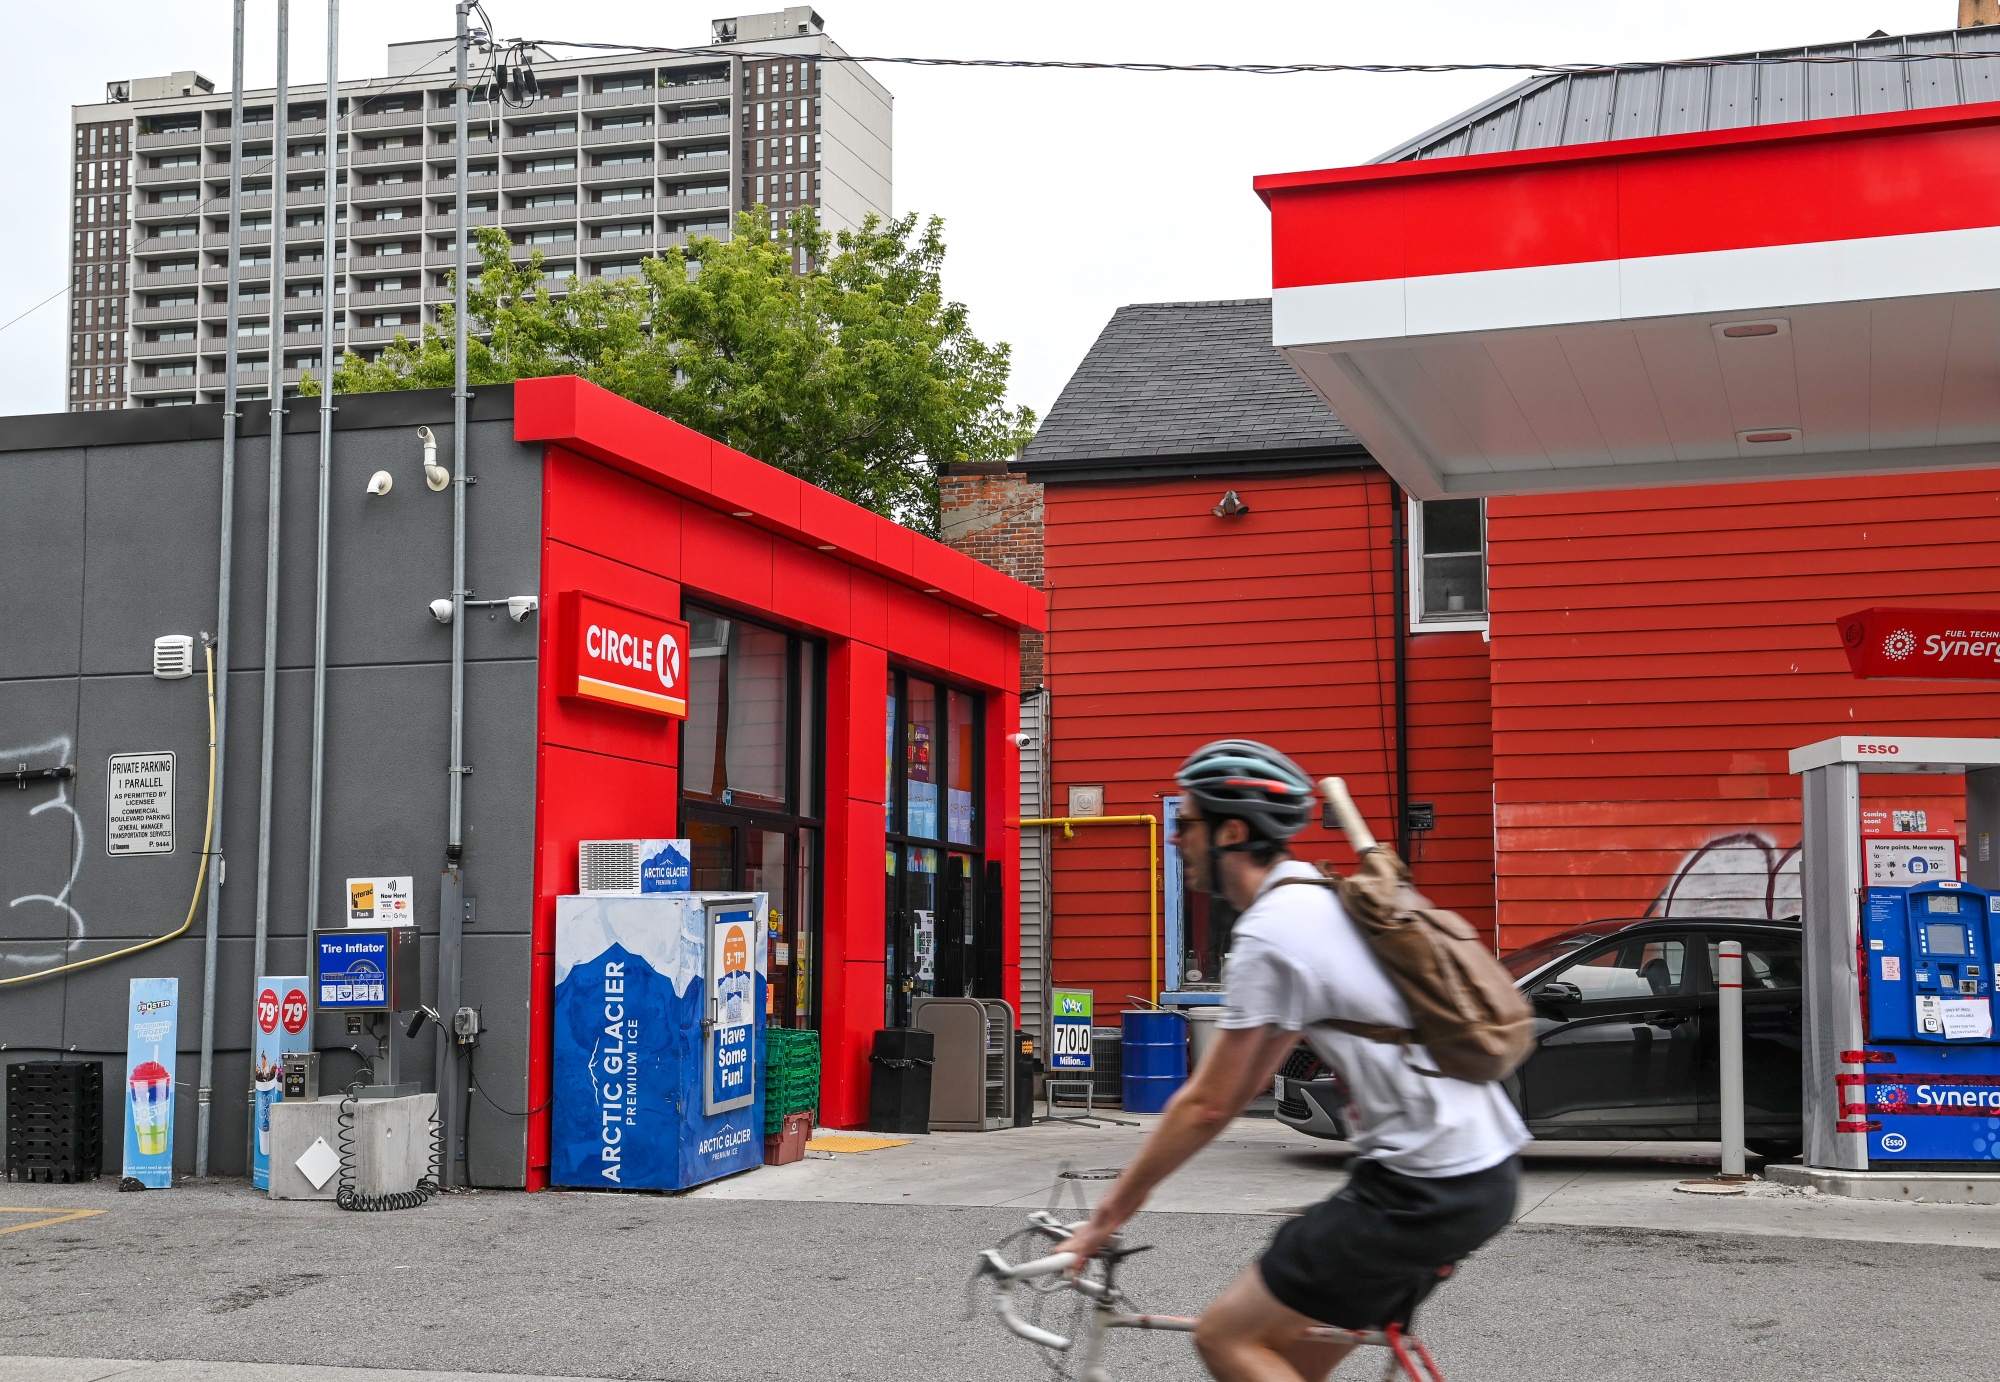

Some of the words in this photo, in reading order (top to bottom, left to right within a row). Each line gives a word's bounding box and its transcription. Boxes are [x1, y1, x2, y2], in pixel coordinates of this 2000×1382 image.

[586, 625, 653, 671] CIRCLE
[656, 633, 679, 688] K
[1857, 745, 1899, 754] ESSO
[112, 762, 139, 774] PRIVATE
[141, 760, 171, 773] PARKING
[125, 777, 163, 788] PARALLEL
[110, 831, 148, 839] TRANSPORTATION
[644, 867, 665, 878] ARCTIC
[666, 866, 688, 877] GLACIER
[352, 888, 374, 900] Interac
[321, 944, 342, 953] Tire
[345, 943, 384, 953] Inflator
[137, 1000, 170, 1012] FROSTER
[260, 1003, 279, 1022] 79¢
[284, 1003, 307, 1022] 79¢
[1062, 998, 1082, 1014] MAX
[134, 1021, 171, 1030] FLAVOURED
[604, 961, 625, 1075] GLACIER
[138, 1027, 169, 1038] FROZEN
[628, 1019, 638, 1044] ICE
[720, 1027, 746, 1046] Have
[1057, 1027, 1089, 1052] 70.0
[718, 1048, 747, 1068] Some
[1060, 1056, 1081, 1066] Million
[721, 1065, 743, 1088] Fun!
[626, 1052, 637, 1126] PREMIUM
[602, 1082, 623, 1183] ARCTIC
[698, 1135, 723, 1155] ARCTIC
[725, 1128, 751, 1148] GLACIER
[1886, 1138, 1903, 1147] Esso
[712, 1149, 730, 1161] PREMIUM
